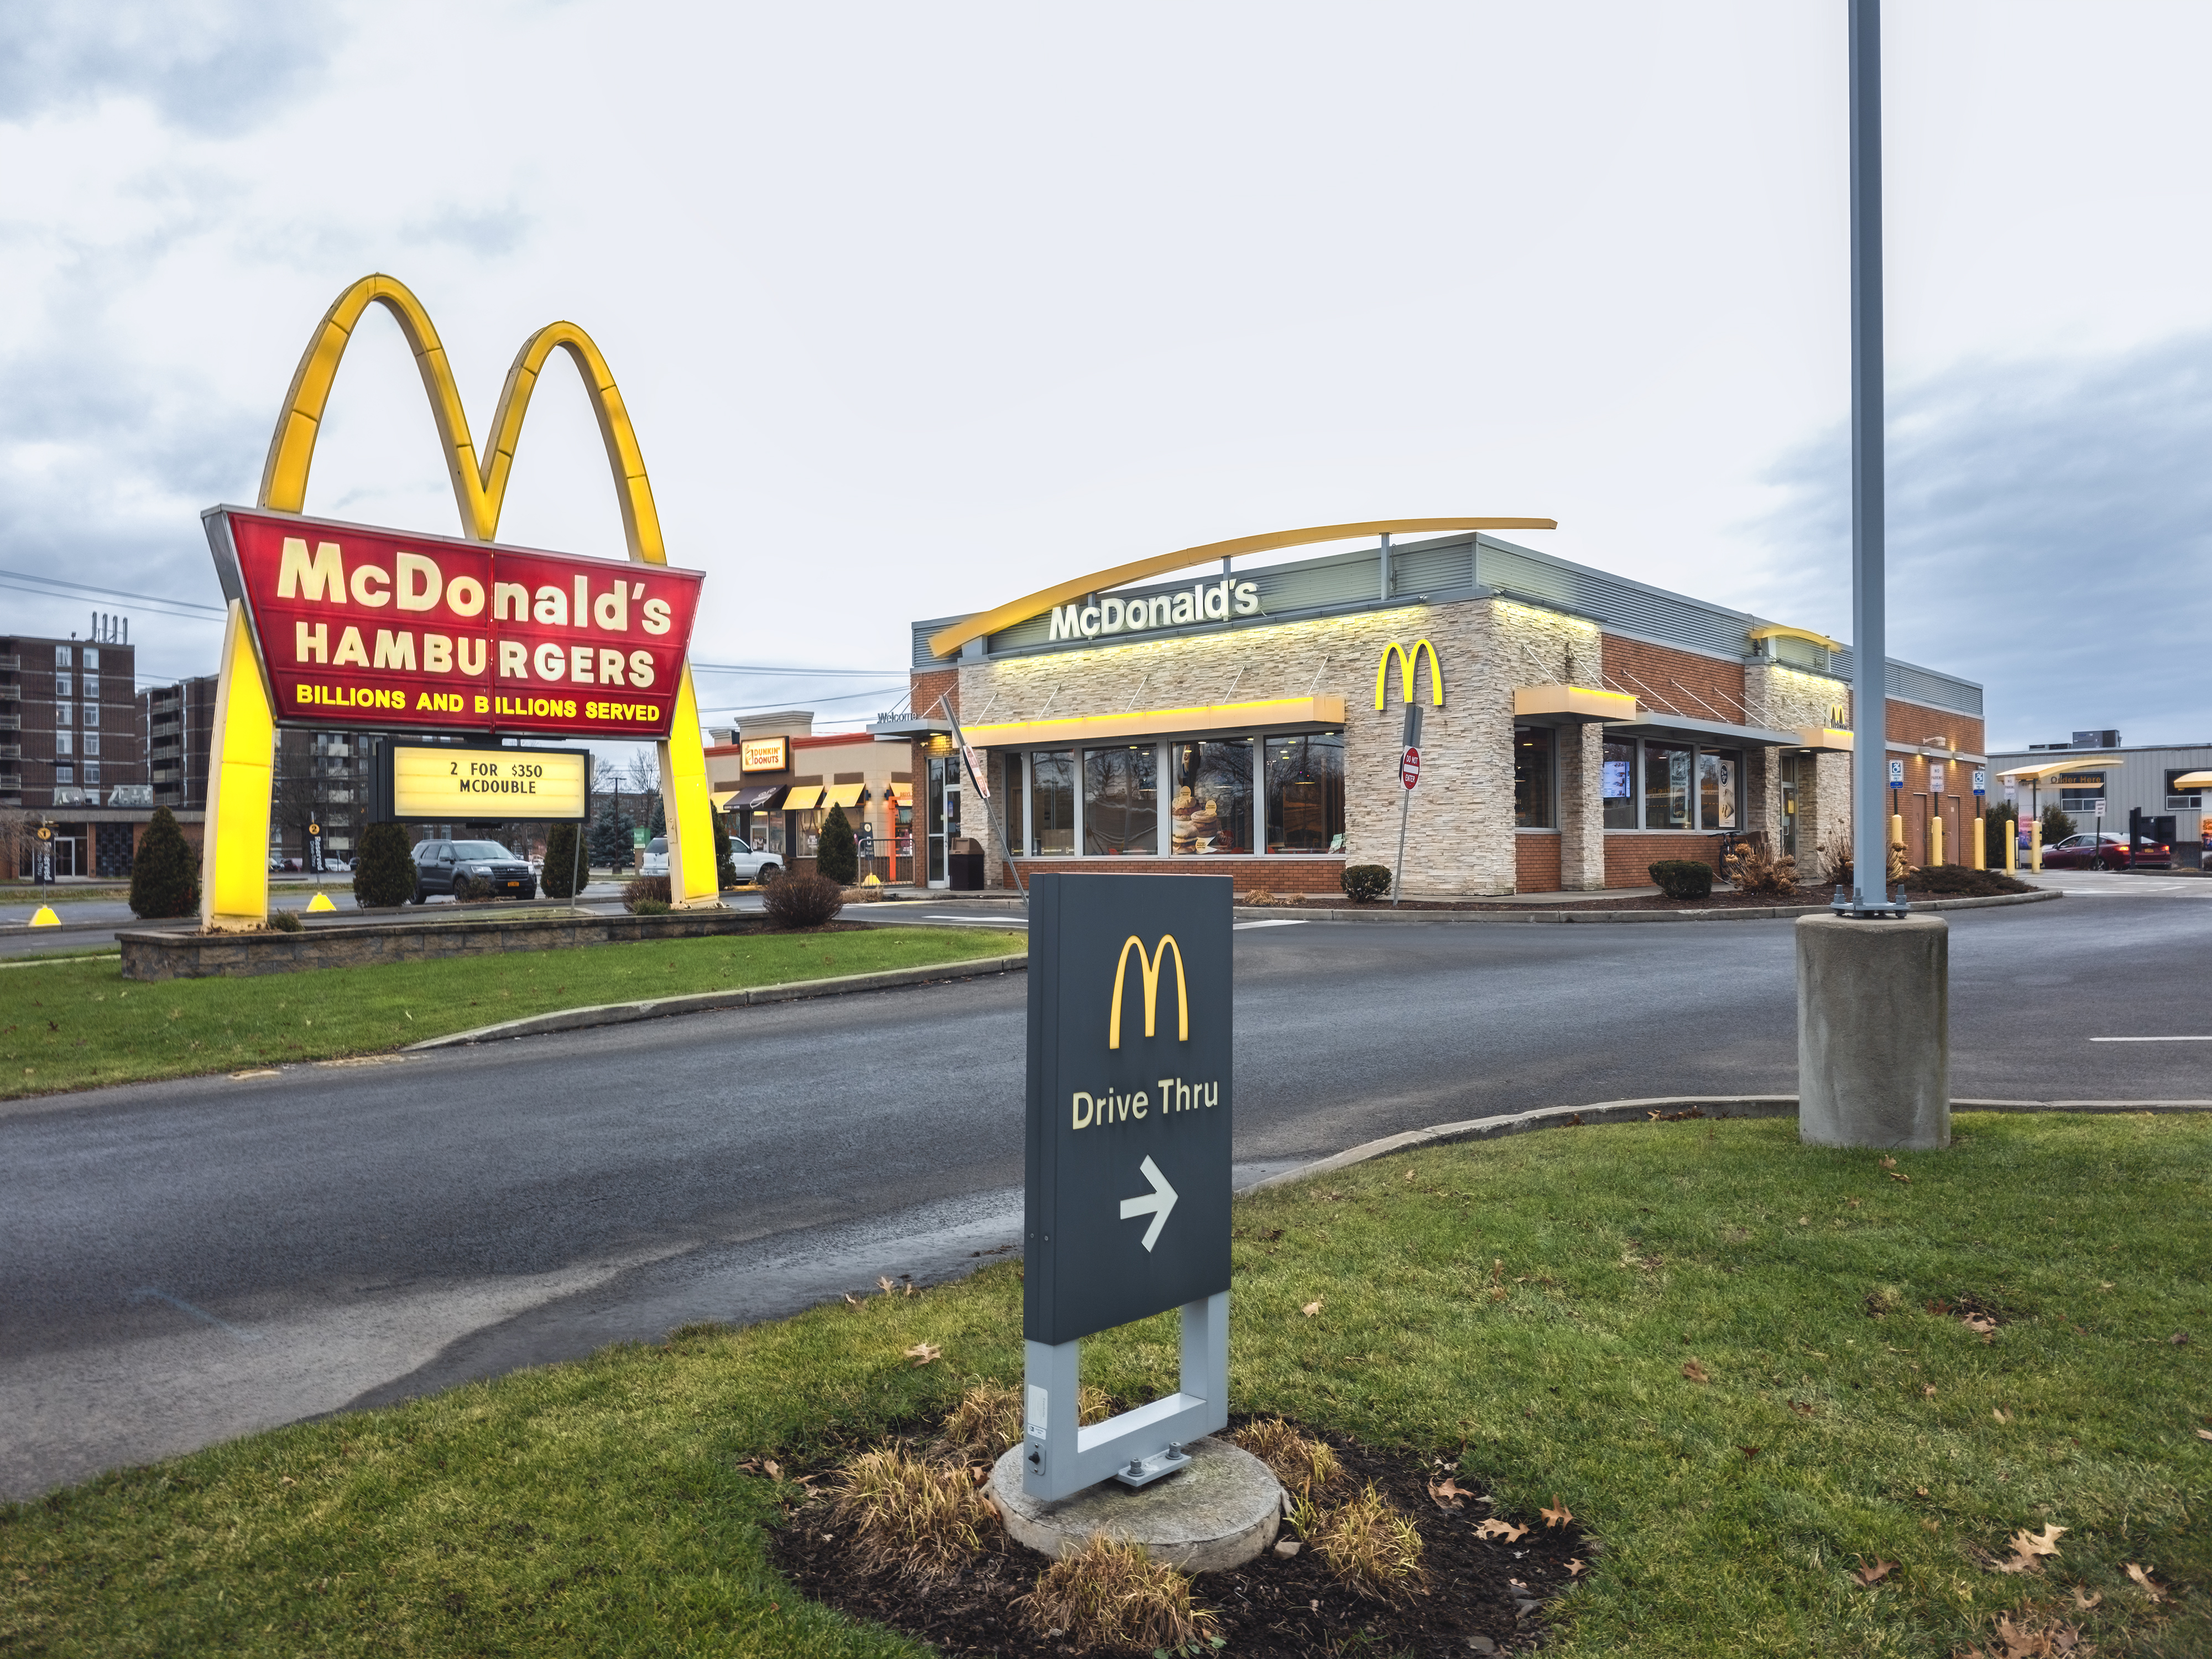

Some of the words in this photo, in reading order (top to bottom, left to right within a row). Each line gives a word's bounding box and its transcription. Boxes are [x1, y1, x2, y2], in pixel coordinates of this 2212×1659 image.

[277, 537, 671, 635] McDonald's
[1049, 579, 1261, 640] McDonald's
[296, 622, 654, 688] HAMBURGERS
[297, 684, 405, 709] BILLIONS
[416, 692, 463, 712] AND
[585, 701, 660, 721] SERVED
[877, 712, 917, 724] Welcome
[754, 747, 780, 757] DUNKIN'
[754, 755, 779, 764] DONUTS
[451, 762, 458, 775] 2
[471, 763, 498, 776] FOR
[512, 764, 542, 778] $350
[1405, 774, 1415, 782] ENTER
[460, 779, 536, 794] MCDOUBLE
[315, 836, 324, 871] Reserved
[1073, 1087, 1149, 1130] Drive
[1157, 1077, 1218, 1114] Thru
